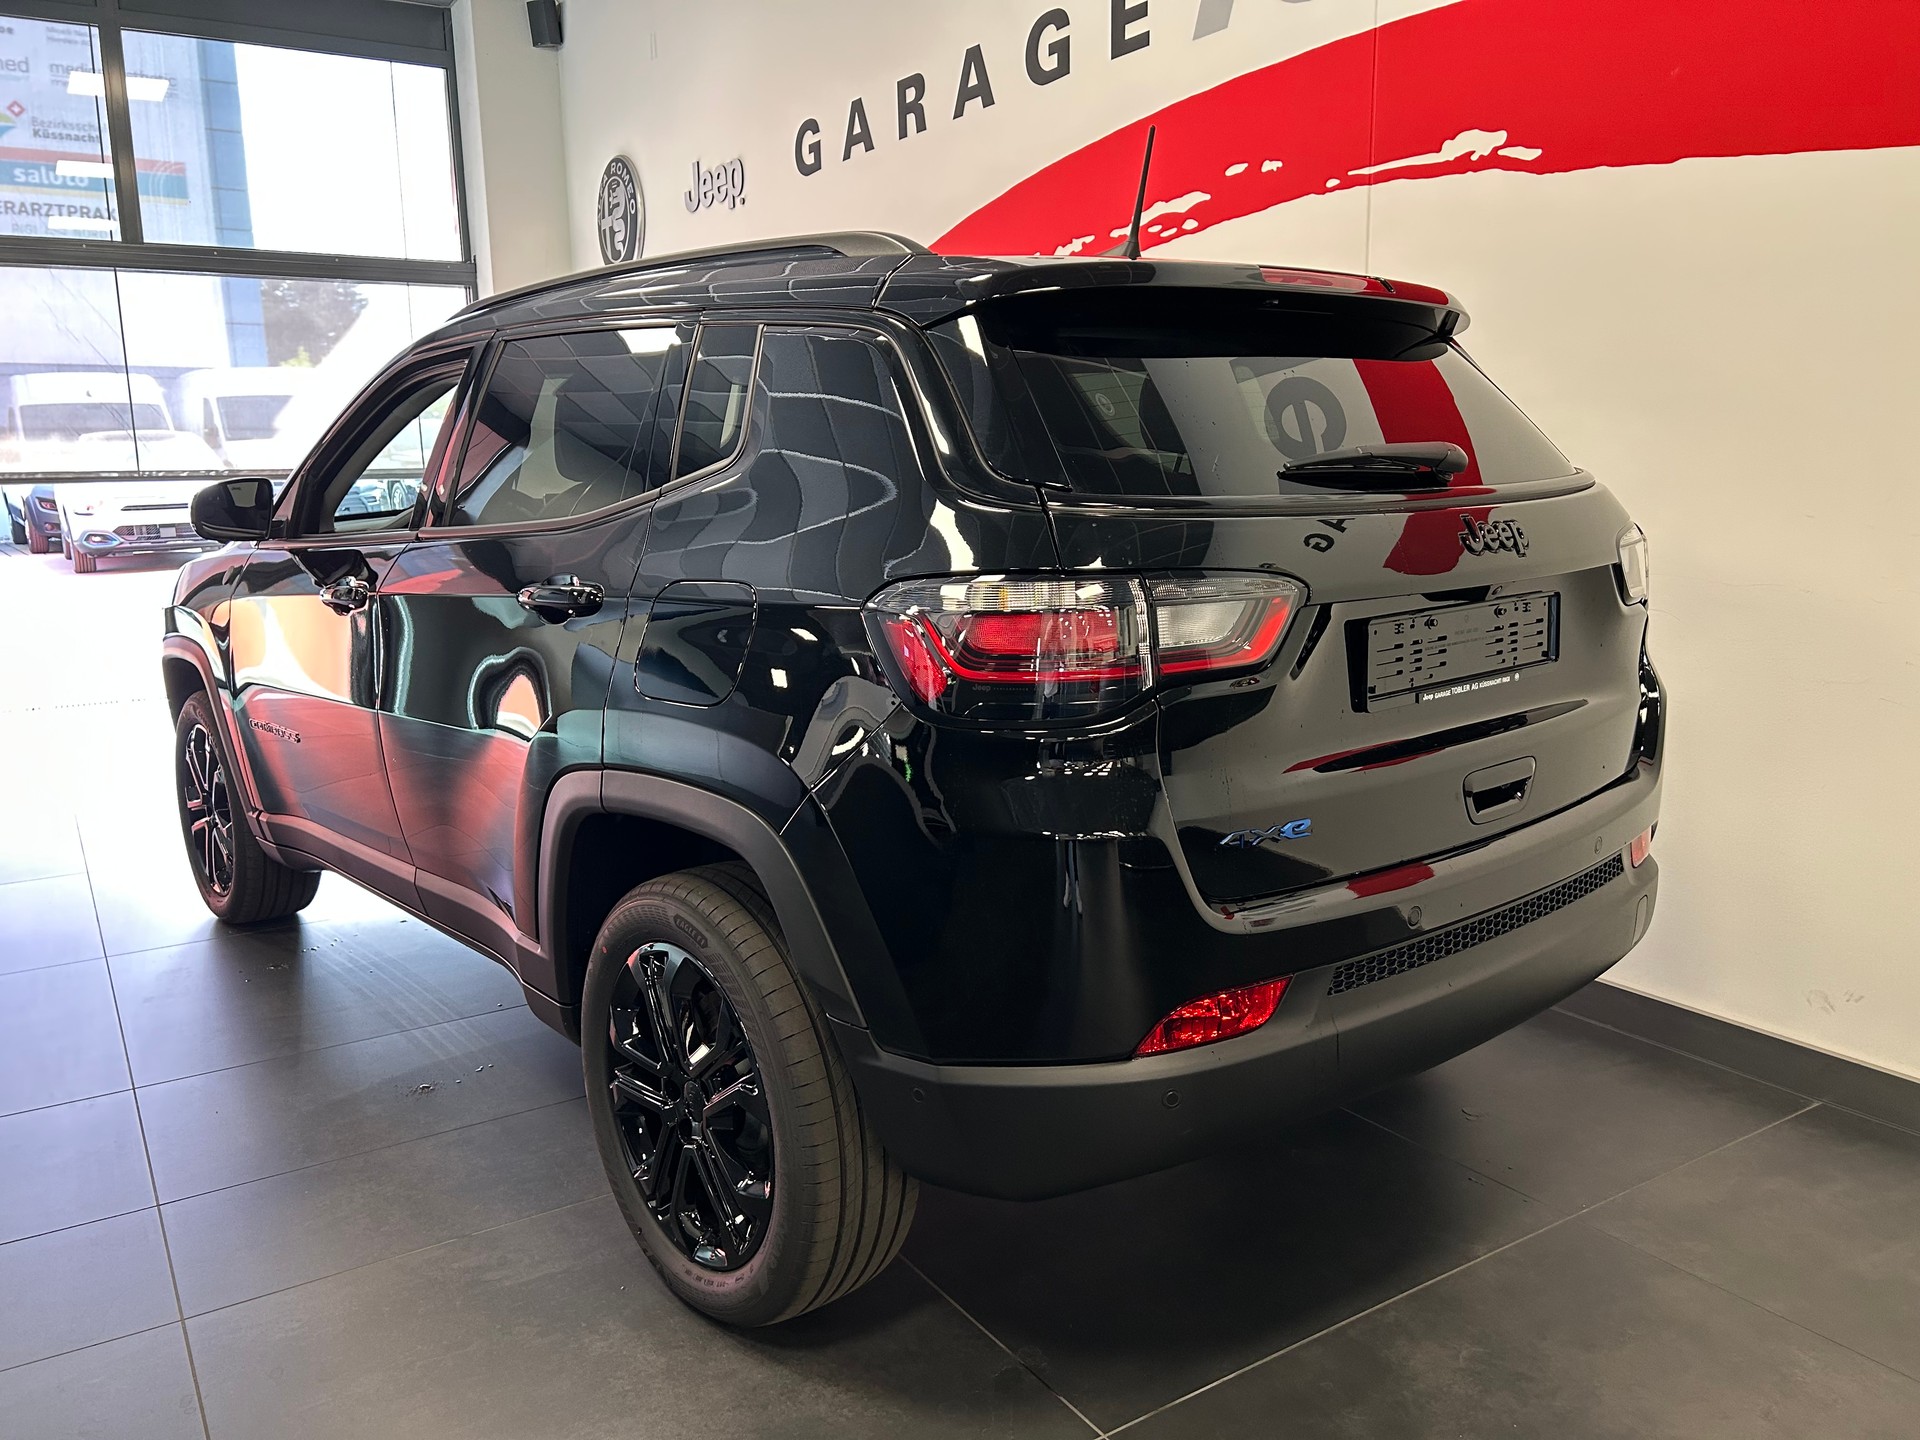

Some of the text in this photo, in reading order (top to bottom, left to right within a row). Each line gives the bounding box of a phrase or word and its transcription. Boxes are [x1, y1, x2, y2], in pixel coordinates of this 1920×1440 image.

[795, 0, 1150, 177] GARAGE
[610, 161, 636, 215] ROMEO
[1459, 513, 1530, 558] Jeep
[1422, 692, 1434, 701] Jeep
[1434, 688, 1452, 699] GARAGE
[1451, 684, 1470, 695] TOBLER
[1471, 682, 1479, 691] AG
